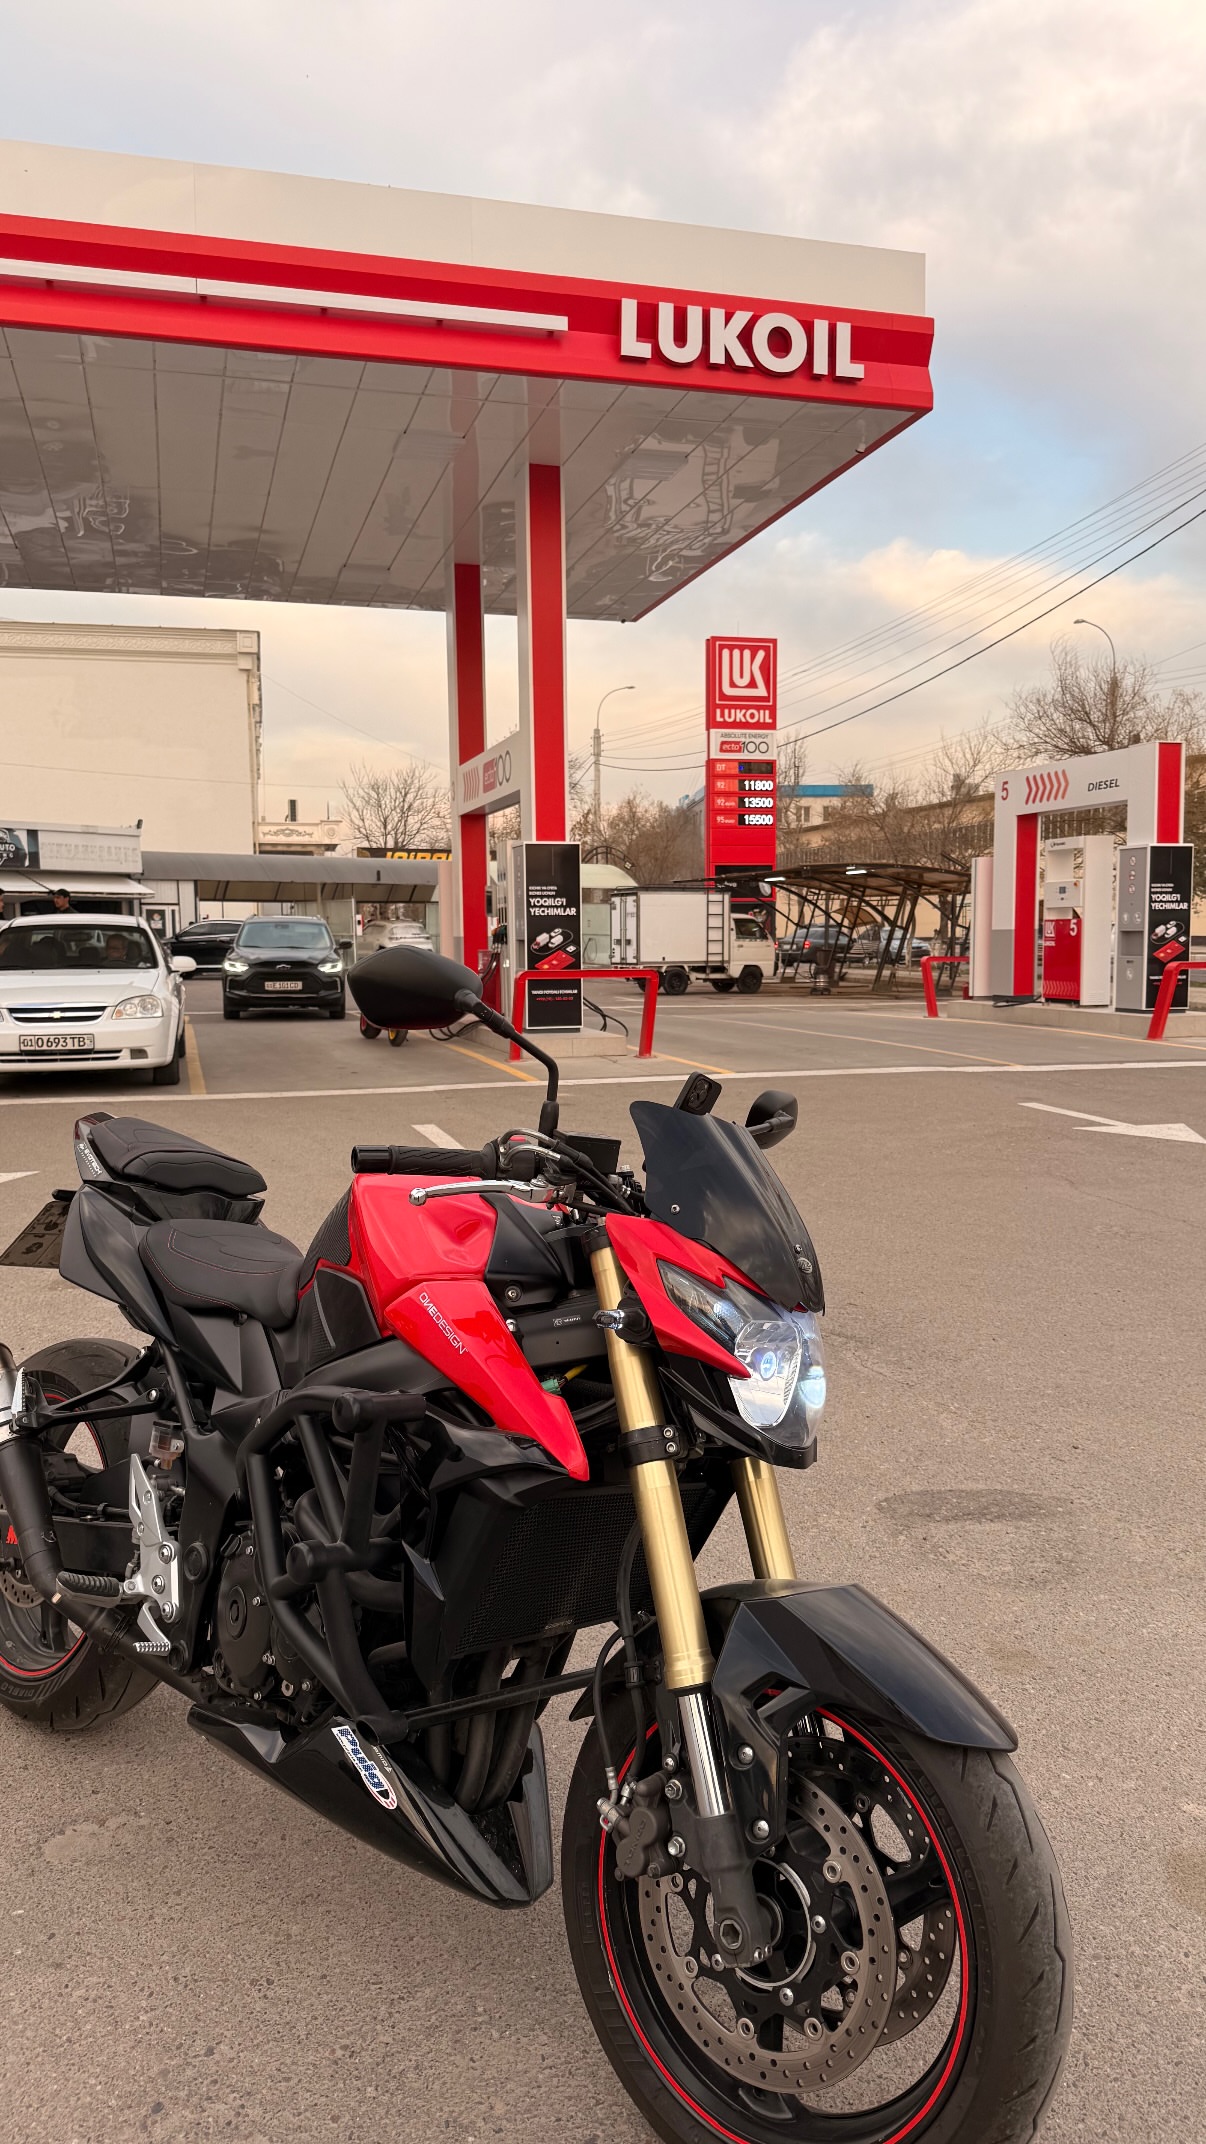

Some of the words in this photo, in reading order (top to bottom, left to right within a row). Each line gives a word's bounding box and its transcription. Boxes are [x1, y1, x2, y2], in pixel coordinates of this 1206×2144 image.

[620, 298, 865, 379] LUKOIL
[722, 648, 769, 697] LUK
[716, 708, 773, 723] LUKOIL
[722, 743, 740, 751] ecto
[740, 741, 770, 754] 100
[744, 780, 774, 791] 11800
[1001, 781, 1009, 801] 5
[1087, 778, 1120, 792] DIESEL
[744, 797, 774, 808] 13500
[744, 814, 774, 825] 15500
[529, 907, 577, 916] YECHIMLAR
[1151, 902, 1189, 910] YECHIMLAR
[1069, 919, 1078, 937] 5
[22, 1038, 34, 1048] 01
[419, 1291, 467, 1355] ONEDESIGN
[337, 1727, 386, 1791] Puig
